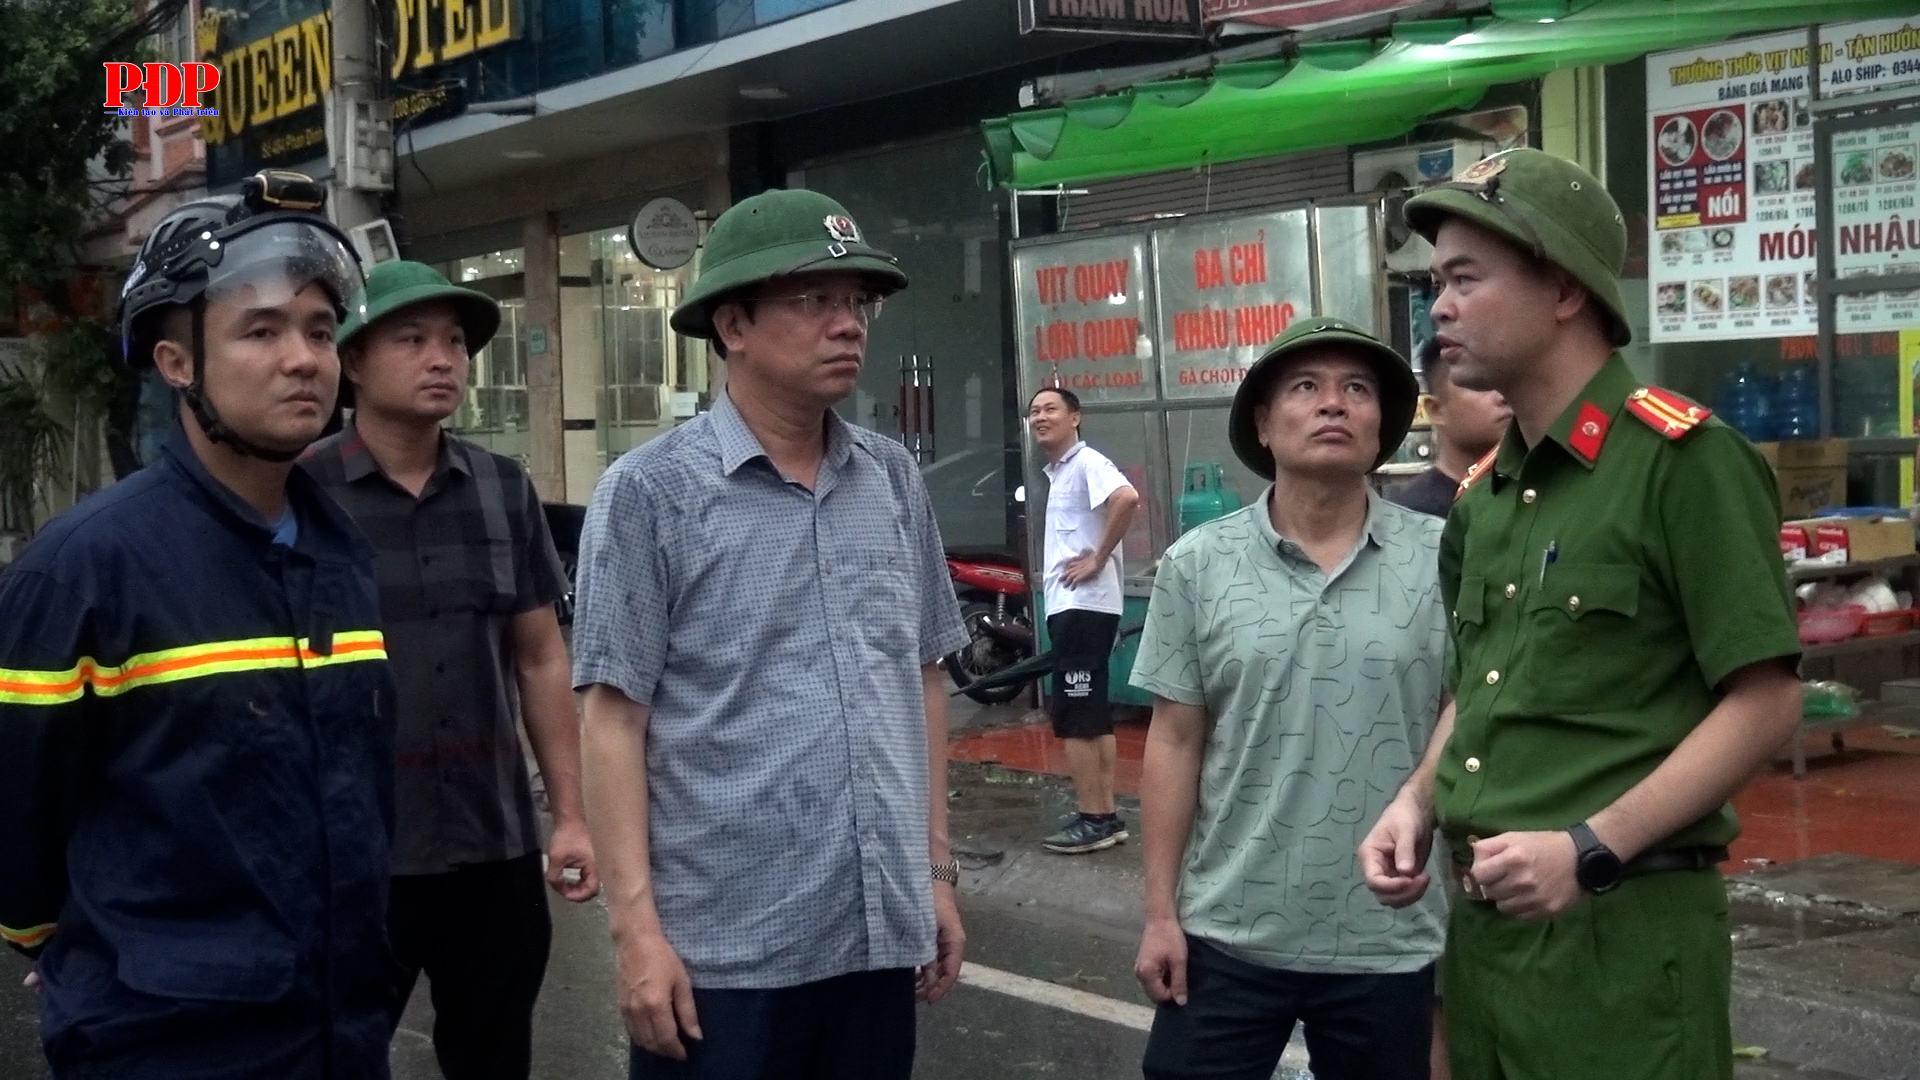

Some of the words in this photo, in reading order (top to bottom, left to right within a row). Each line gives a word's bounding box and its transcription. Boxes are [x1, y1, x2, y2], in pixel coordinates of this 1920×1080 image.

[1764, 49, 1788, 75] VỊT
[1790, 43, 1833, 69] NGN
[1845, 33, 1878, 63] TẬN
[1750, 77, 1768, 97] GIÁ
[1771, 74, 1804, 93] MANG
[1831, 68, 1853, 86] ALO
[1856, 64, 1887, 81] SHIP:
[1194, 248, 1226, 290] BA
[1229, 228, 1267, 287] CHỈ
[1036, 266, 1069, 311] VỊT
[1074, 258, 1129, 308] QUAY
[1083, 316, 1139, 360] QUAY
[1179, 367, 1197, 386] GÀ
